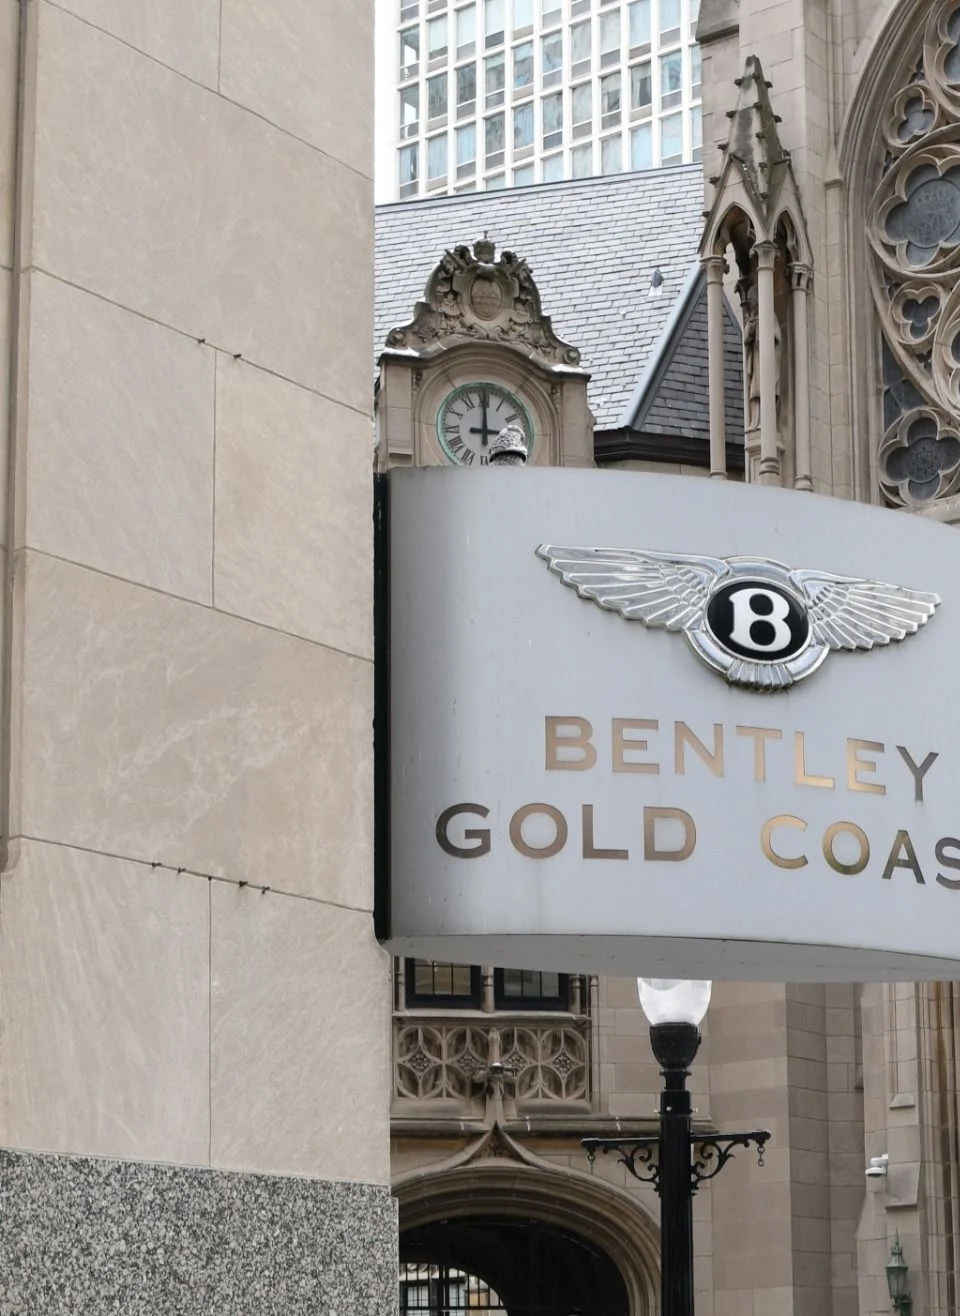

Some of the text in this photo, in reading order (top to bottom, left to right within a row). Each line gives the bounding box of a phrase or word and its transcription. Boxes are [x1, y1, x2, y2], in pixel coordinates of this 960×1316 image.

[504, 412, 520, 423] II
[728, 588, 792, 653] B
[544, 715, 940, 802] BENTLEY
[435, 802, 697, 863] GOLD
